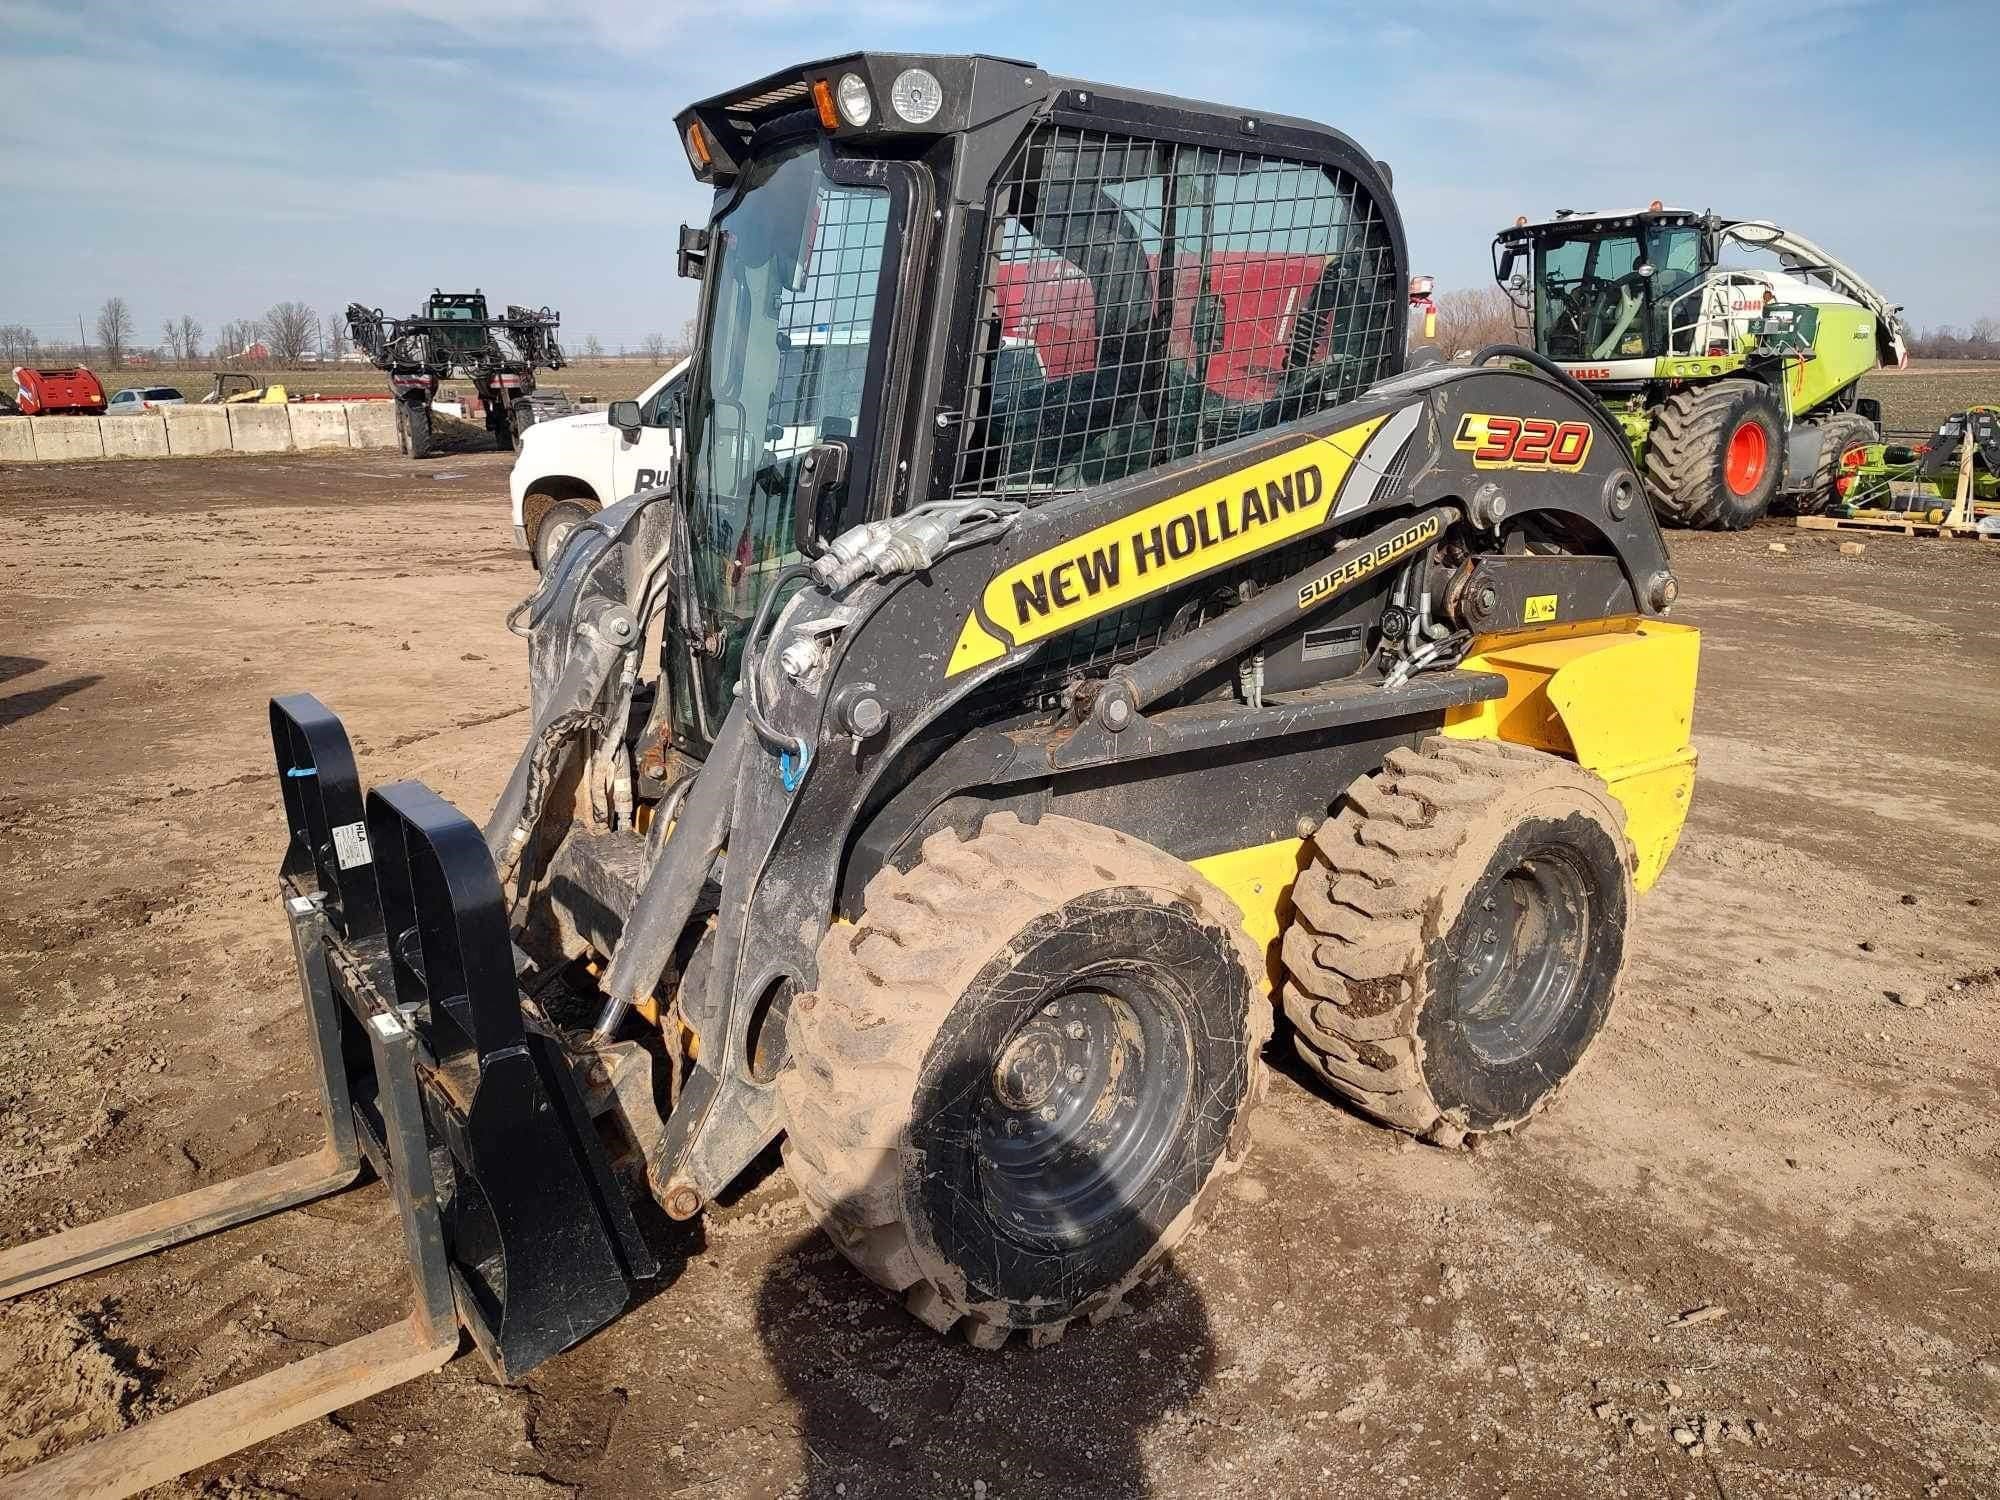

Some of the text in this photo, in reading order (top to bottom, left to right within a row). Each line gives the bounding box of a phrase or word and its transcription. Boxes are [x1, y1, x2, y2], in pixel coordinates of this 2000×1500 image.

[1011, 463, 1323, 626] NEW HOLLAND
[1299, 517, 1437, 605] SUPER BOOM
[355, 823, 366, 842] HLA
